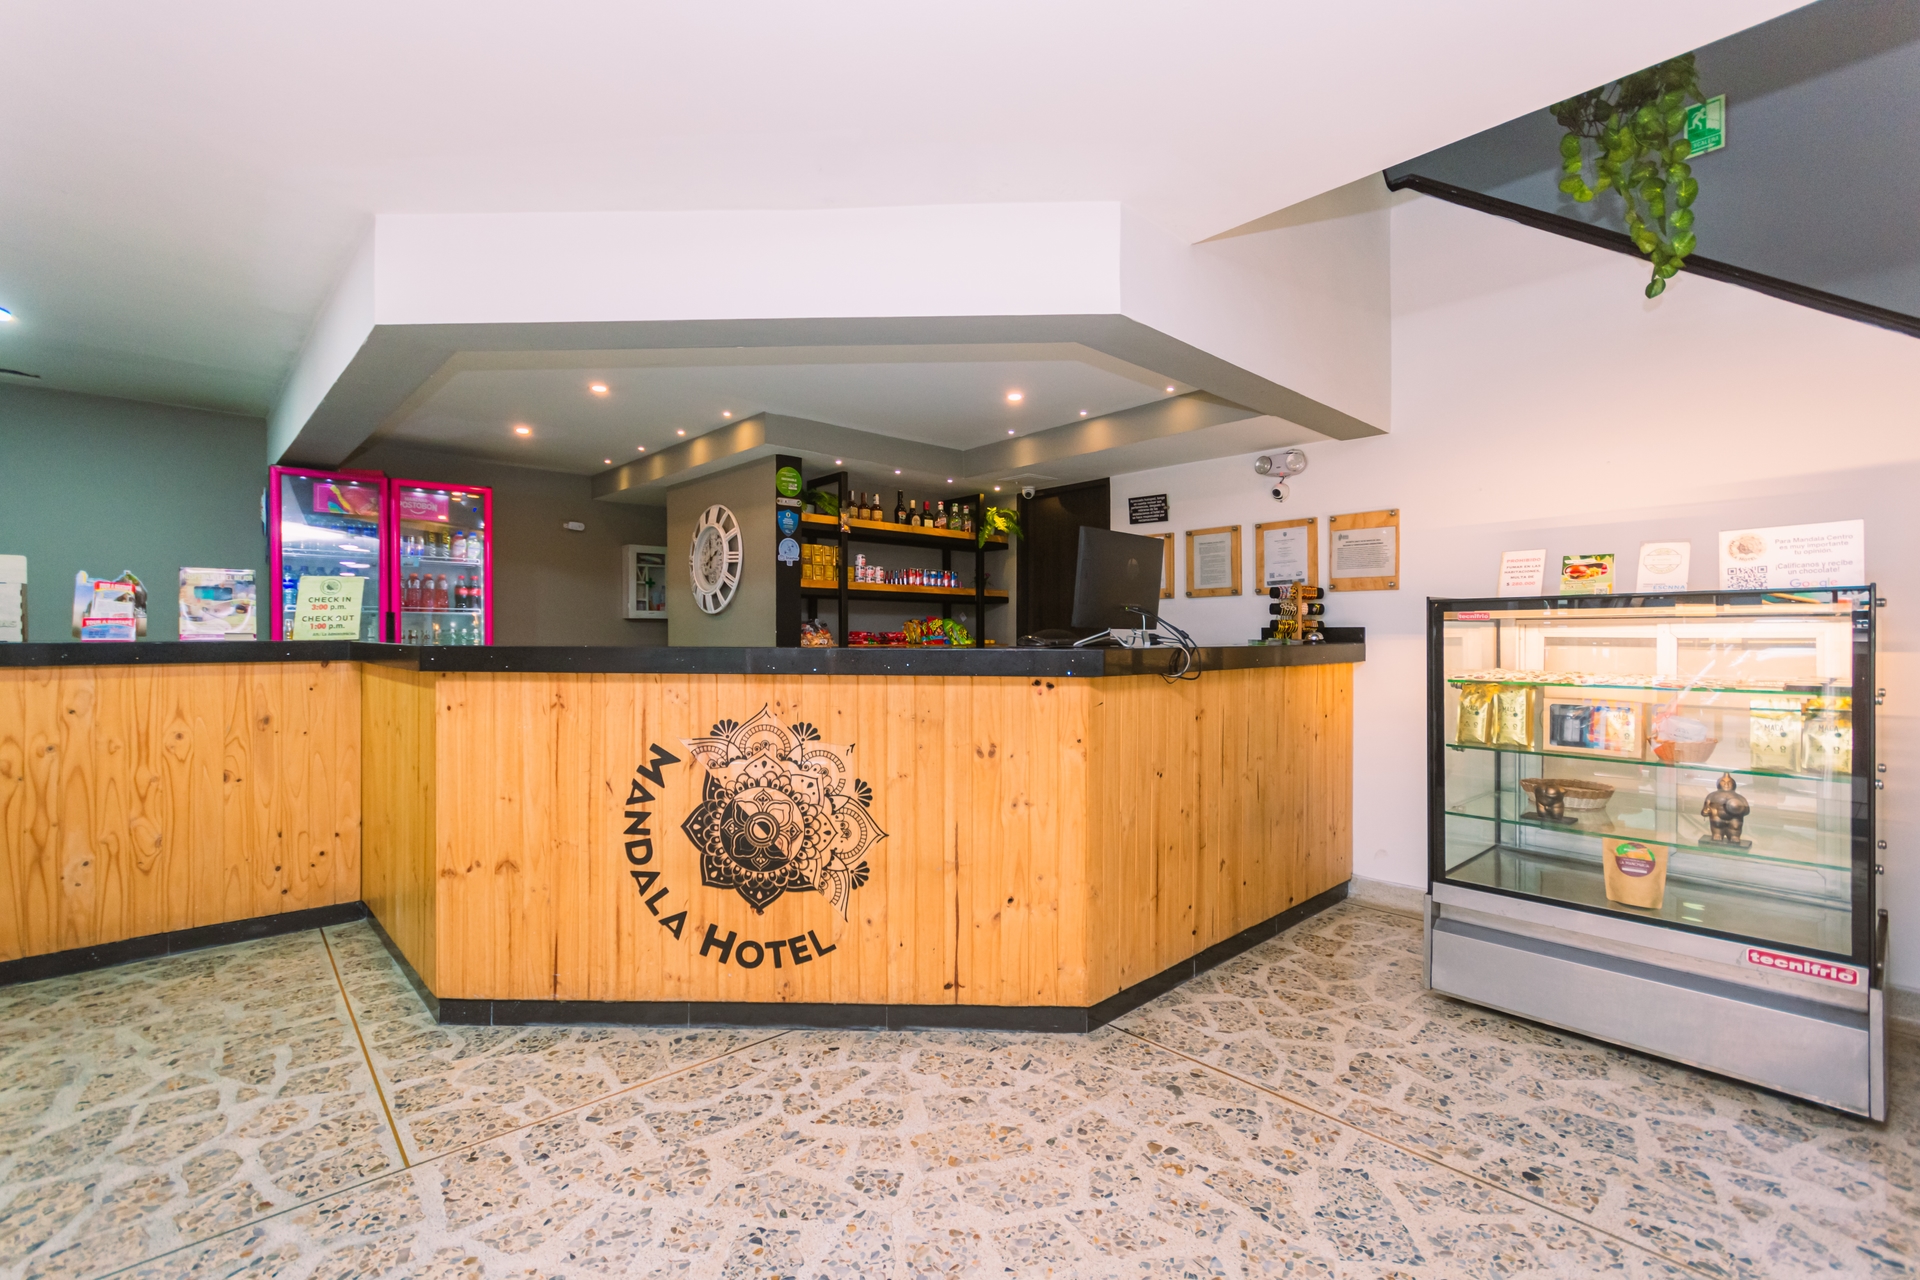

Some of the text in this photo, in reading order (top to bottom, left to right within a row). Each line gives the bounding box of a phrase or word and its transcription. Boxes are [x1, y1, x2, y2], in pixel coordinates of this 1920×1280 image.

[1807, 540, 1849, 549] importante
[1799, 566, 1840, 574] chocolate!
[1789, 577, 1838, 588] Google
[335, 614, 355, 622] OUT
[1764, 724, 1785, 732] MACA
[1818, 724, 1839, 732] MACA
[623, 742, 838, 969] MANDALA HOTEL
[1749, 951, 1854, 983] tecnifrio
